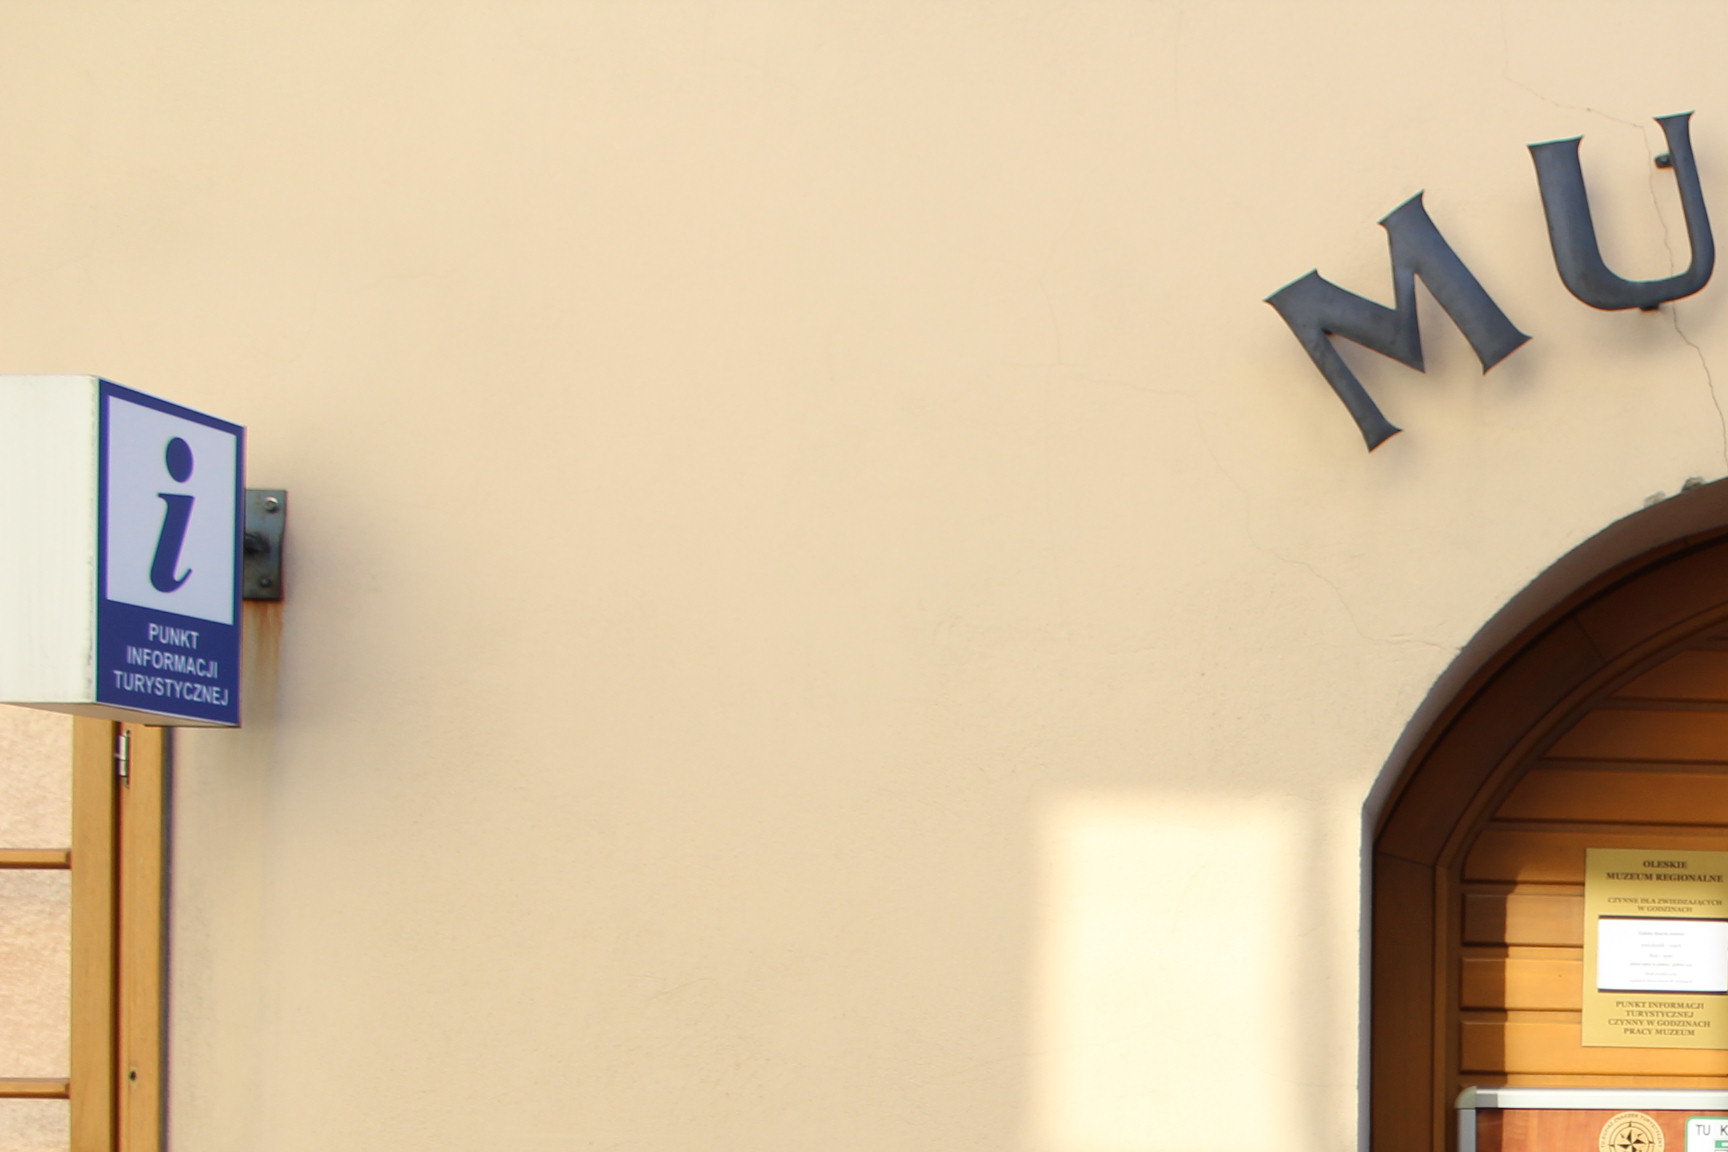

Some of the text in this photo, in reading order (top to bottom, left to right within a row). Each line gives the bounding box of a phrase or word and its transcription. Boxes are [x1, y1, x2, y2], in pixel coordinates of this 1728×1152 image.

[148, 623, 199, 650] PUNKT
[126, 645, 218, 679] INFORMACJI
[113, 669, 229, 706] TURYSTYCZNEJ
[1642, 860, 1687, 869] OLESKIE
[1606, 872, 1724, 883] MUZEUM REGIONALNE
[1657, 898, 1722, 906] ZWIEDZAJĄCYCH
[1646, 905, 1693, 913] GODZINACH
[1615, 1001, 1704, 1010] PUNKT INFORMACJI
[1625, 1010, 1694, 1018] TURYSTYCZNEJ
[1607, 1018, 1645, 1027] CZYNNY
[1657, 1020, 1711, 1028] GODZINACH
[1655, 1028, 1695, 1036] MUZEUM
[1695, 1124, 1711, 1136] TU
